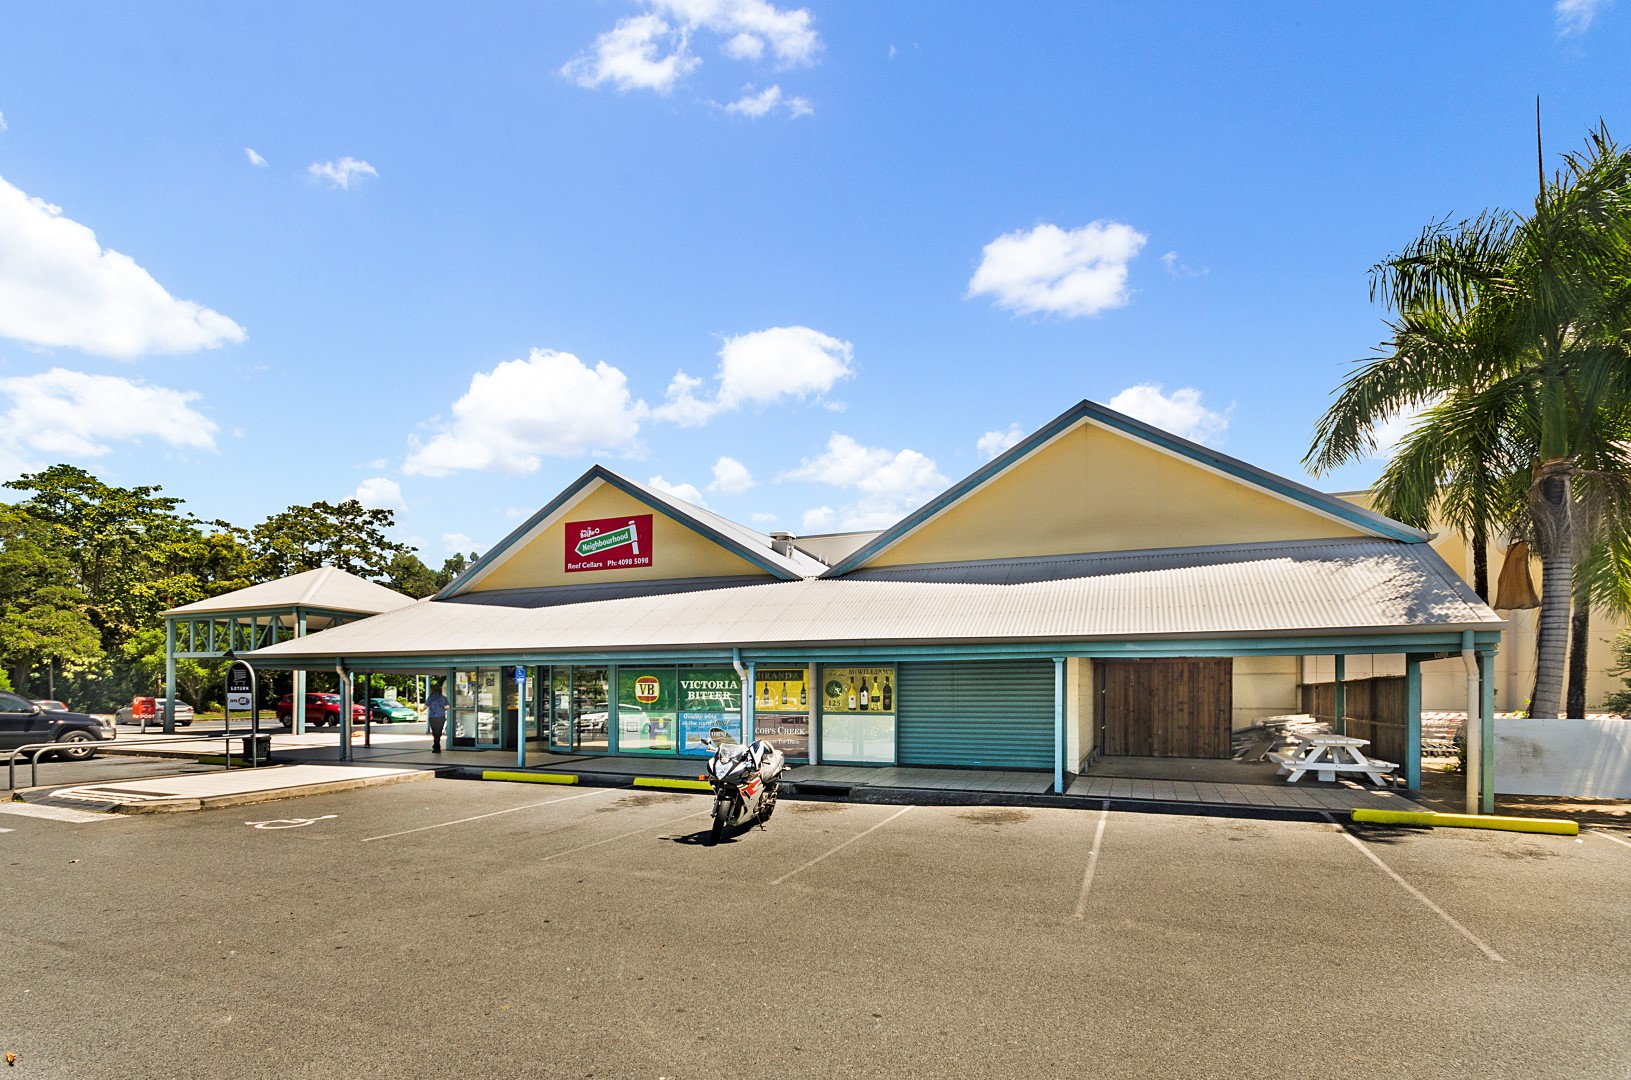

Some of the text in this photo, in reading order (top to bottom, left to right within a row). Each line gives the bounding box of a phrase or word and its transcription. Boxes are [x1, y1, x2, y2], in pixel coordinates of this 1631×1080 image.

[582, 532, 629, 551] Neighbourhood
[618, 558, 633, 566] 4098
[634, 557, 649, 565] 5098
[756, 671, 799, 680] MIRANDA
[639, 683, 655, 695] VB
[680, 680, 739, 690] VICTORIA
[687, 690, 731, 700] BITTER
[755, 726, 806, 735] COB'S CREEK
